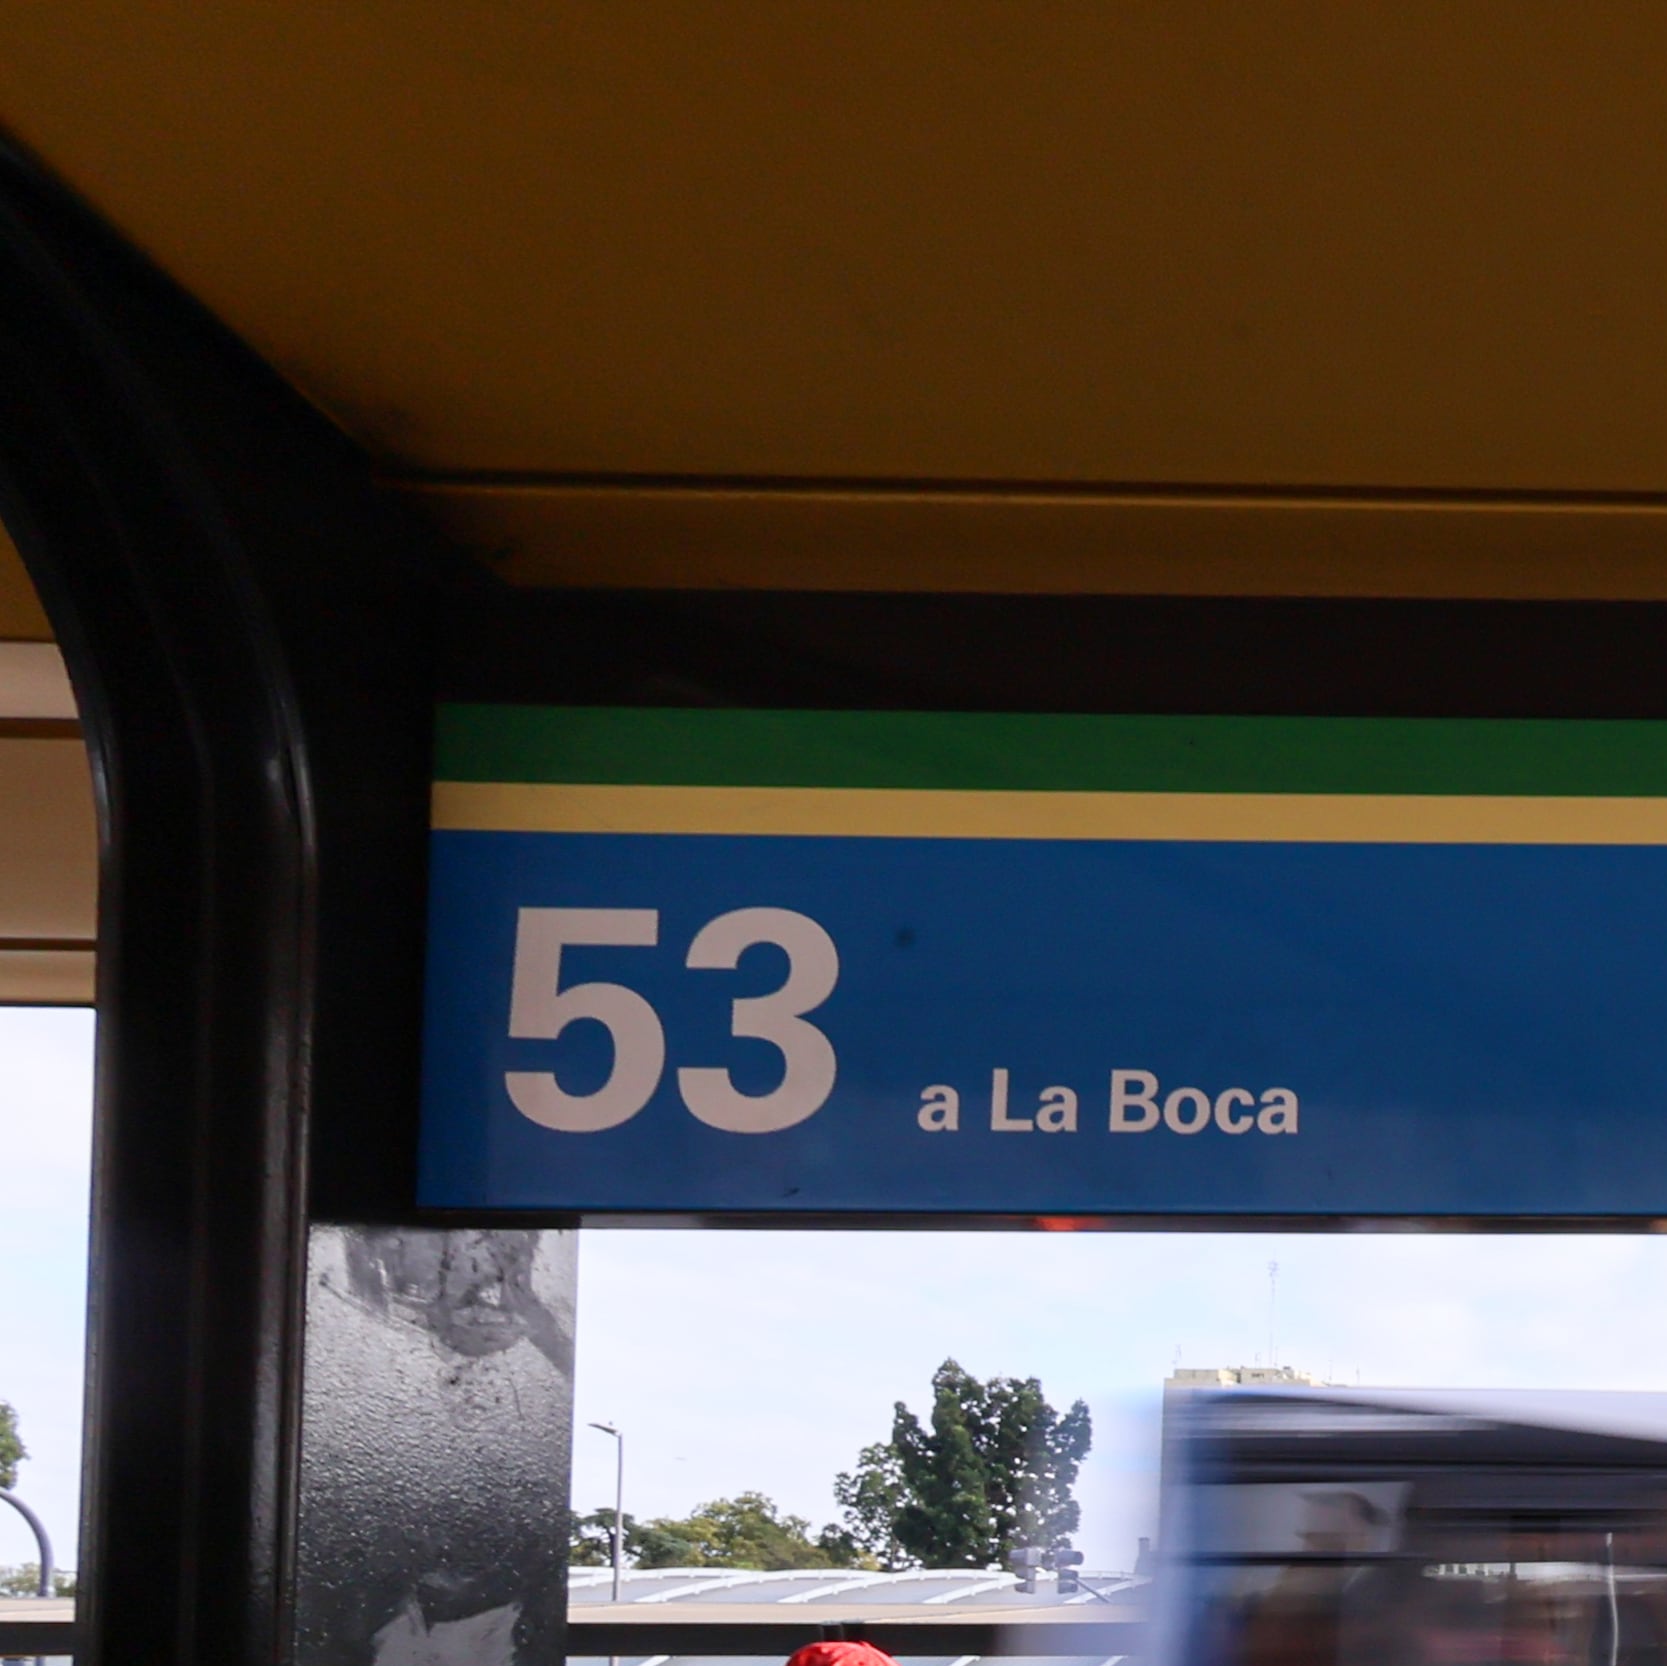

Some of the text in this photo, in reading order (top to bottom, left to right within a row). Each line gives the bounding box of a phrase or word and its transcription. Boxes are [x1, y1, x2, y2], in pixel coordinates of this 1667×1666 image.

[506, 907, 839, 1134] 53
[917, 1069, 1300, 1135] a La Boca
